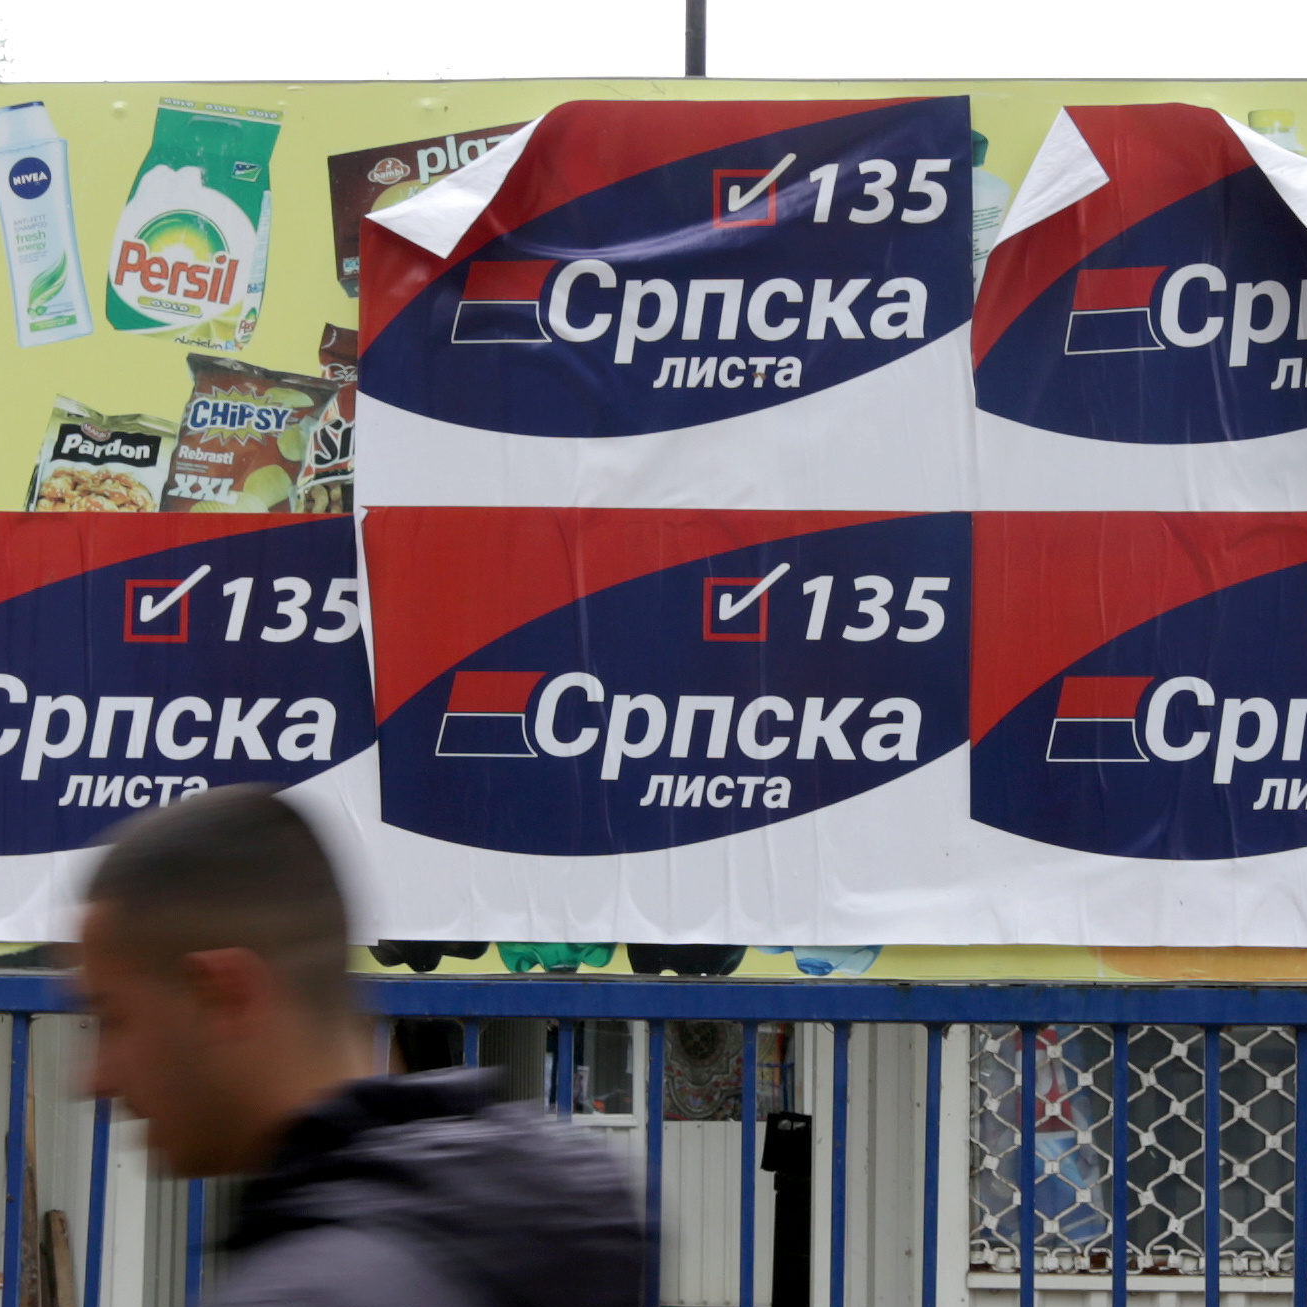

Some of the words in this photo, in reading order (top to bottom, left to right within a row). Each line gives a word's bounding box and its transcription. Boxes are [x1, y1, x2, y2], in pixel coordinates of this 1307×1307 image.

[13, 171, 48, 186] NIVEA
[808, 158, 951, 225] 135
[15, 230, 46, 244] fresh
[114, 240, 239, 305] Persil
[547, 259, 929, 364] Српска
[653, 355, 802, 389] листа
[61, 433, 151, 460] Pardon
[167, 473, 238, 504] XXL
[221, 576, 361, 643] 135
[802, 575, 950, 643] 135
[534, 672, 923, 780] Српска
[58, 774, 209, 808] листа
[640, 774, 792, 809] листа
